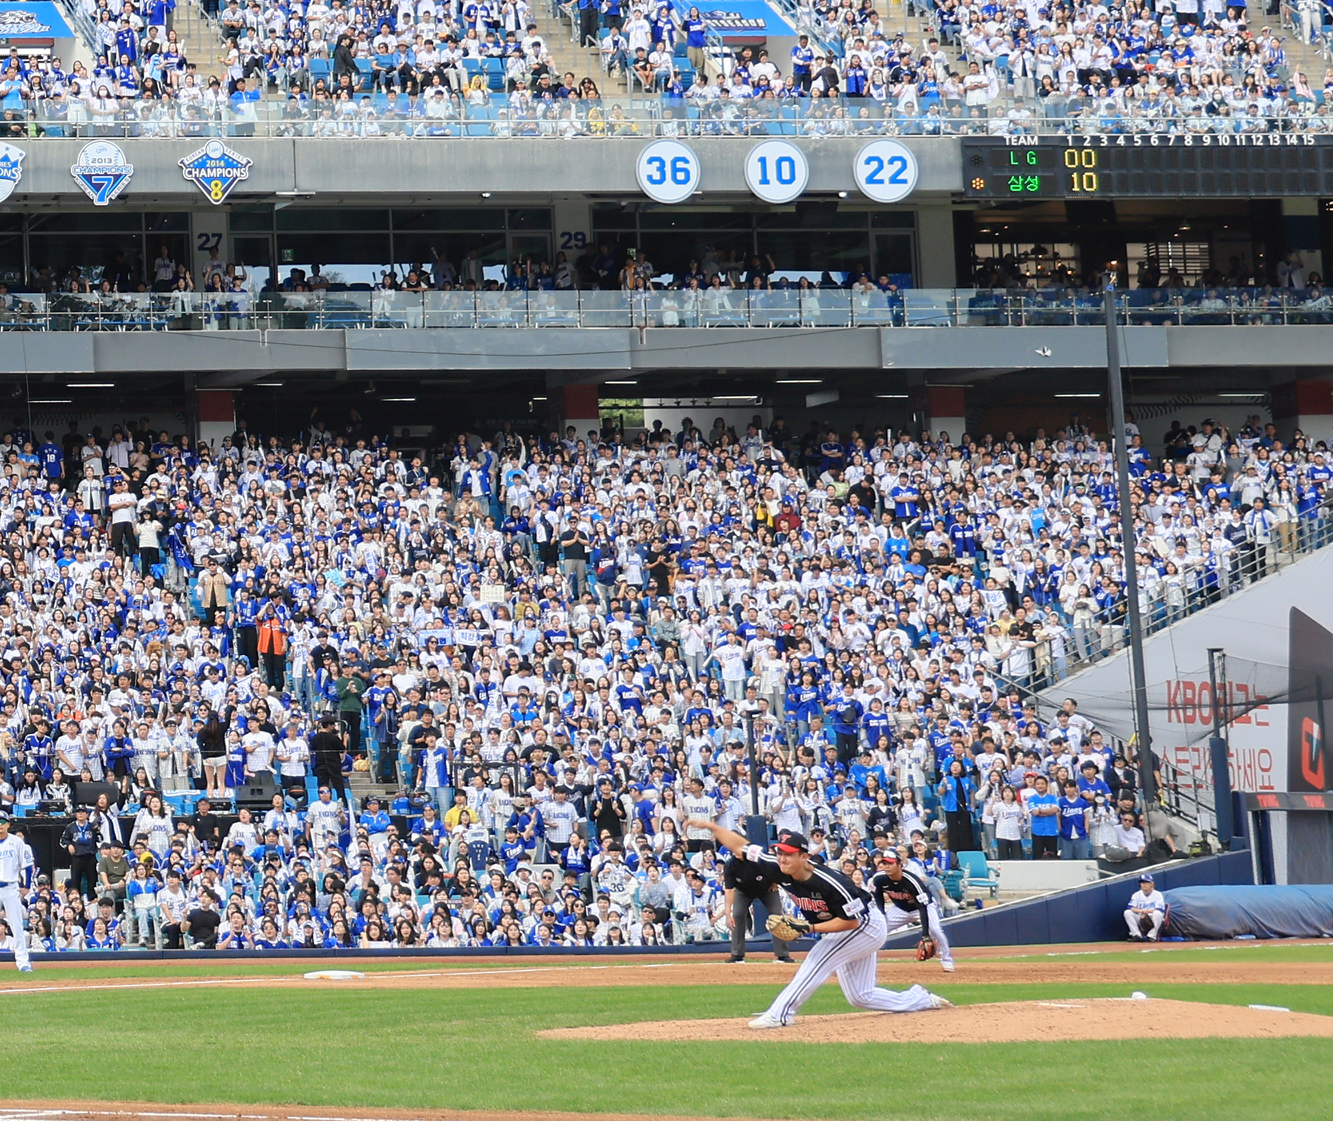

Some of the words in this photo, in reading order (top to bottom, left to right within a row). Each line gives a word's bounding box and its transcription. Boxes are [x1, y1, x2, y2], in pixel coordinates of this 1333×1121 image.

[1004, 135, 1038, 146] TEAM
[1066, 135, 1072, 146] 1
[1083, 135, 1091, 146] 2
[1100, 135, 1108, 146] 3
[1116, 135, 1125, 146] 4
[1134, 135, 1141, 146] 5
[1150, 135, 1159, 146] 6
[1167, 135, 1176, 146] 7
[1184, 135, 1193, 146] 8
[1202, 135, 1211, 146] 9
[1217, 135, 1230, 146] 10
[1234, 135, 1246, 146] 11
[1251, 135, 1263, 146] 12
[1267, 135, 1280, 146] 13
[1285, 135, 1298, 146] 14
[1302, 135, 1315, 146] 15
[185, 149, 204, 162] KOREAN
[225, 148, 244, 162] SERIES
[73, 166, 132, 174] CHAMPIONS
[185, 168, 246, 177] CHAMPIONS
[646, 156, 691, 185] 36
[758, 156, 796, 185] 10
[864, 156, 908, 185] 22
[75, 177, 95, 199] KOREAN
[111, 177, 130, 200] SERIES
[92, 176, 114, 202] 7
[210, 180, 223, 200] 8
[1008, 176, 1039, 192] 삼성
[197, 233, 223, 251] 27
[560, 231, 587, 250] 29
